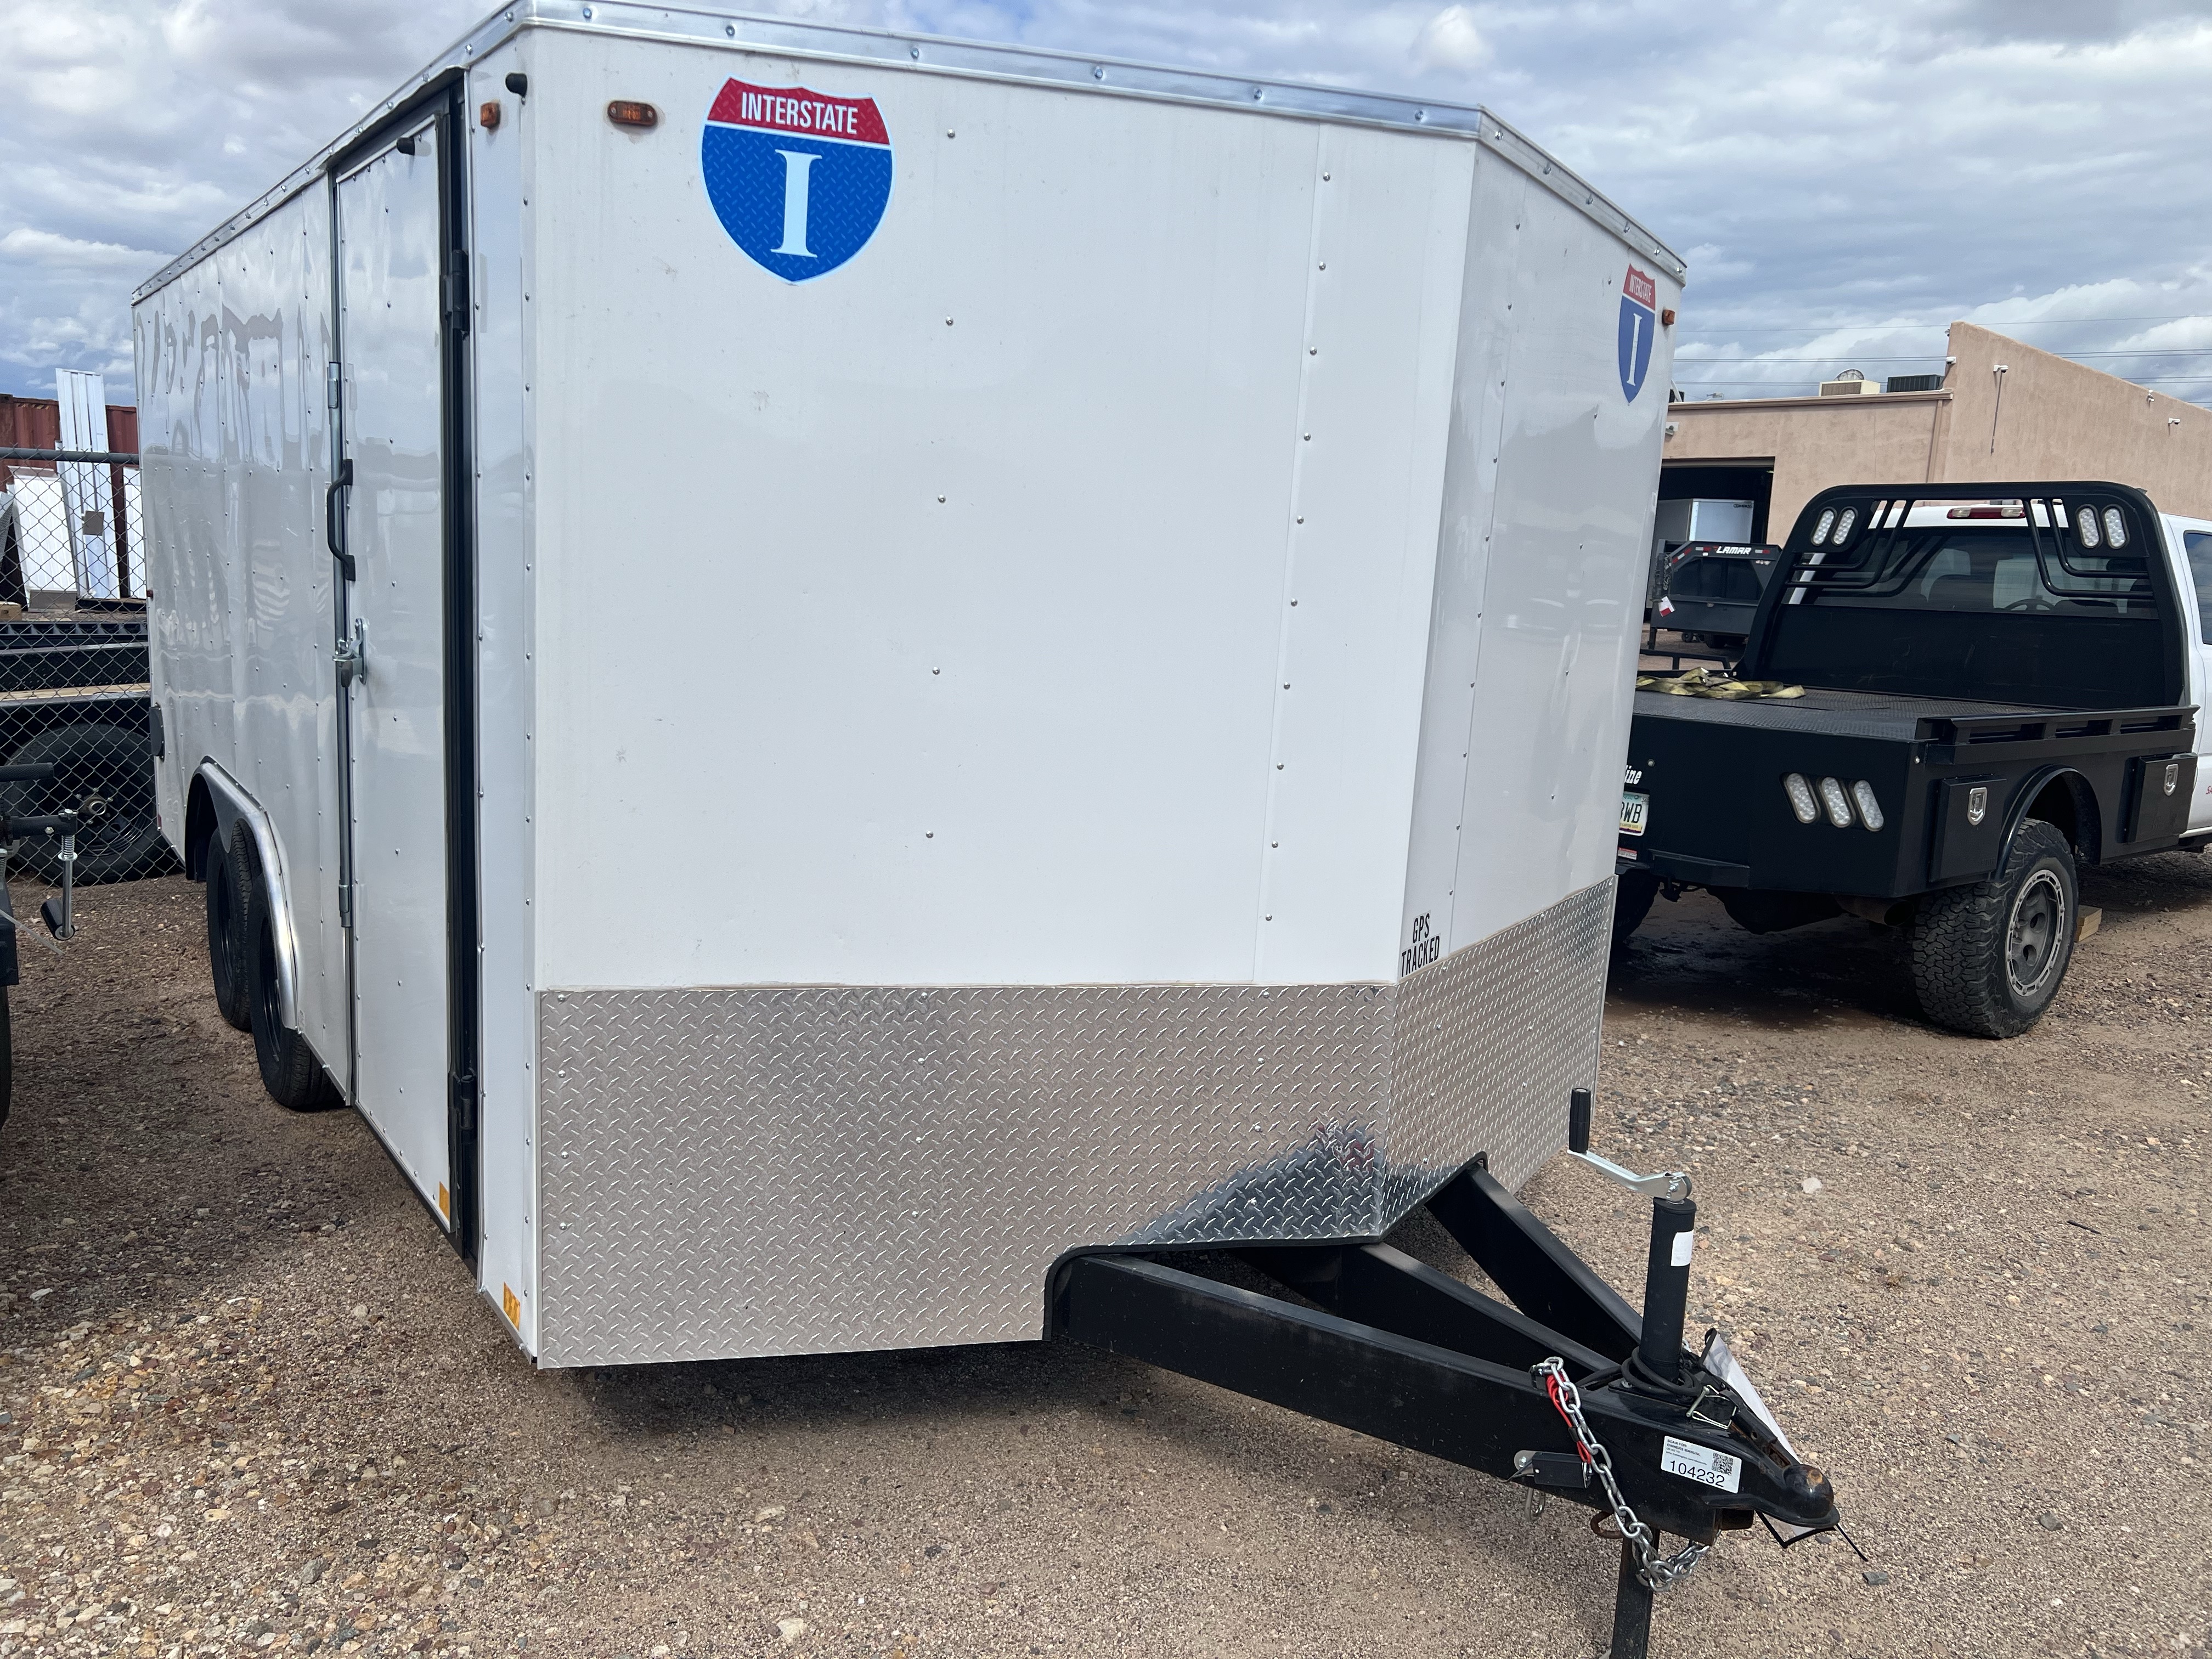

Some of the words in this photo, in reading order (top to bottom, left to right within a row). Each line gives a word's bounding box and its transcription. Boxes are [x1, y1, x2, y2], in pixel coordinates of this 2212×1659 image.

[741, 91, 858, 135] INTERSTATE
[770, 149, 822, 258] I
[1629, 273, 1652, 303] INTERSTATE
[1626, 313, 1643, 386] I
[1716, 546, 1752, 555] LAMAR
[1624, 765, 1642, 785] ine
[1413, 913, 1430, 943] GPS
[1401, 935, 1440, 978] TRACKED
[1684, 1448, 1701, 1457] MANUAL
[1670, 1460, 1725, 1488] 104232
